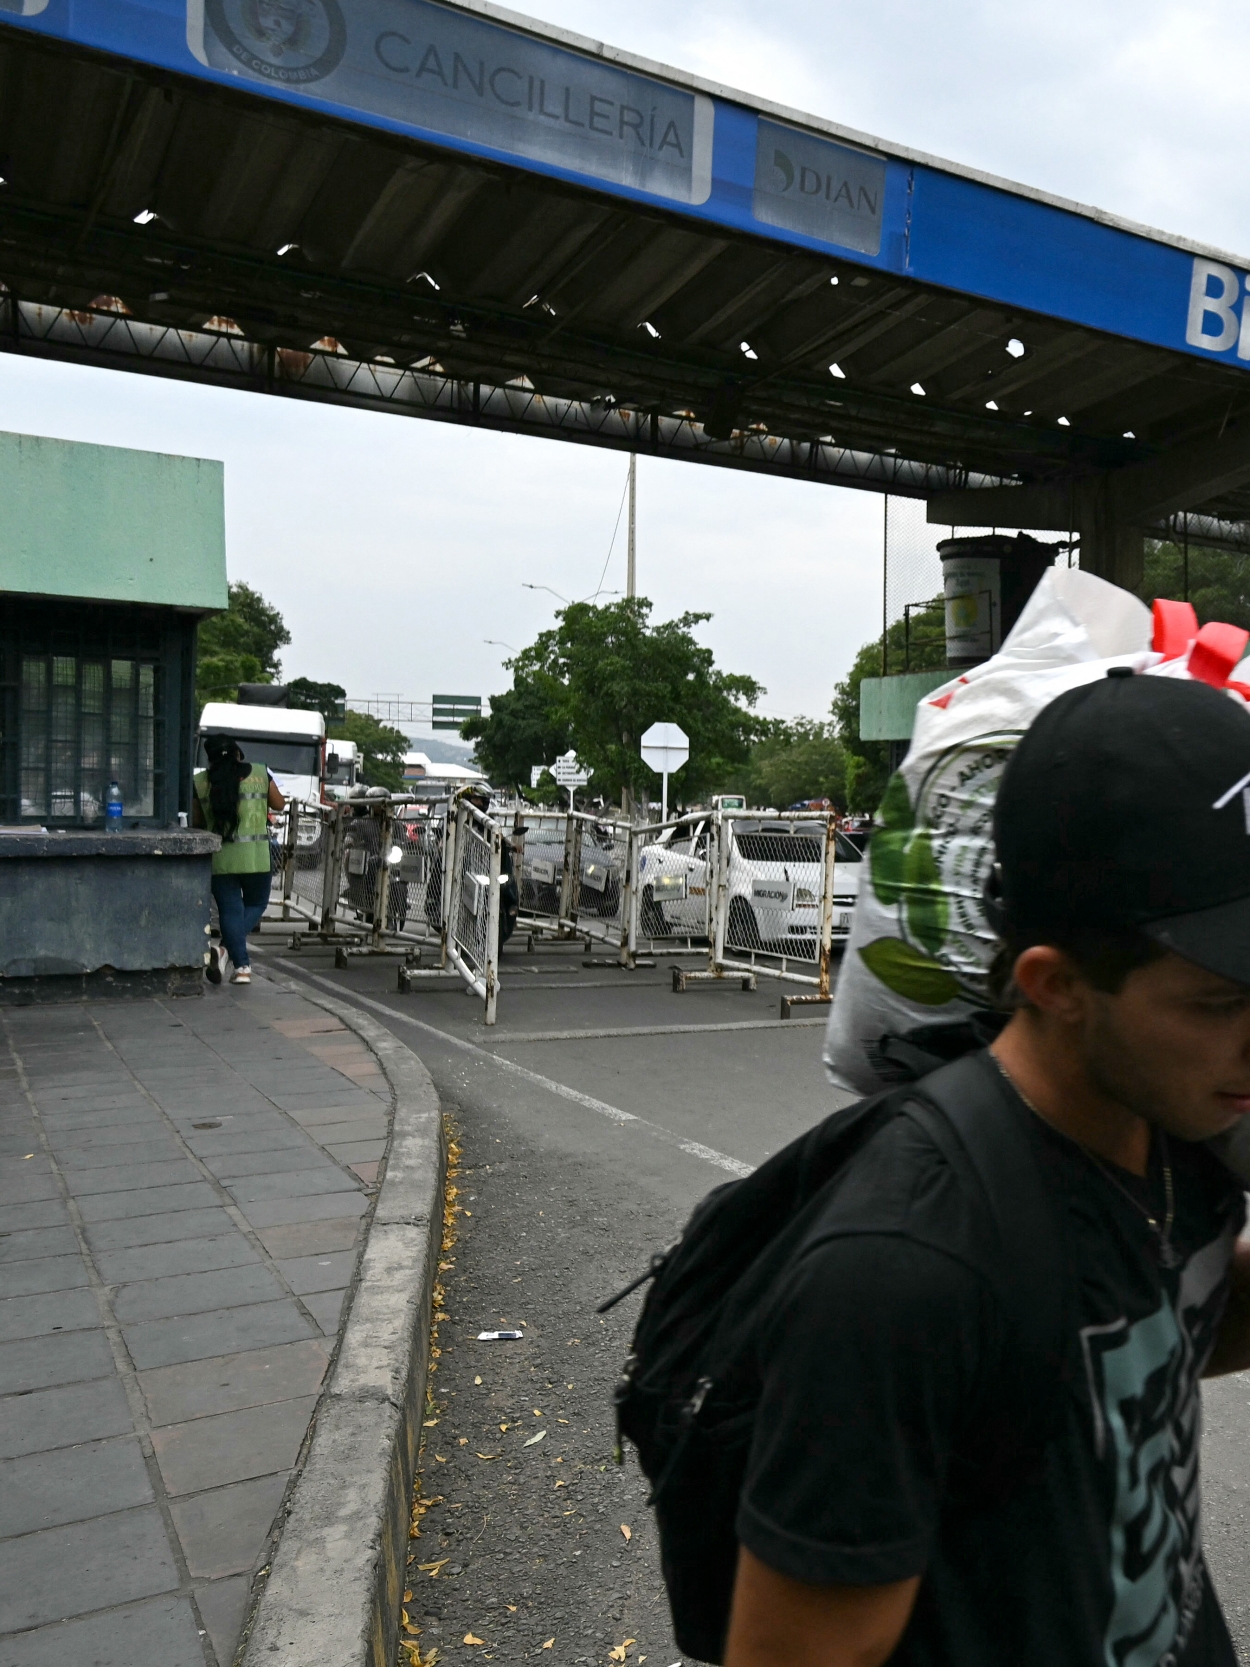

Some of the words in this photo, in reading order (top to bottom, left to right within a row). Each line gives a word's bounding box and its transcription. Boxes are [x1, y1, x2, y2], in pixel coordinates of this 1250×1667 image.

[233, 44, 250, 62] DE
[252, 60, 320, 80] COLOMBIA
[374, 31, 685, 159] CANCILLERÍA
[800, 166, 877, 216] DIAN
